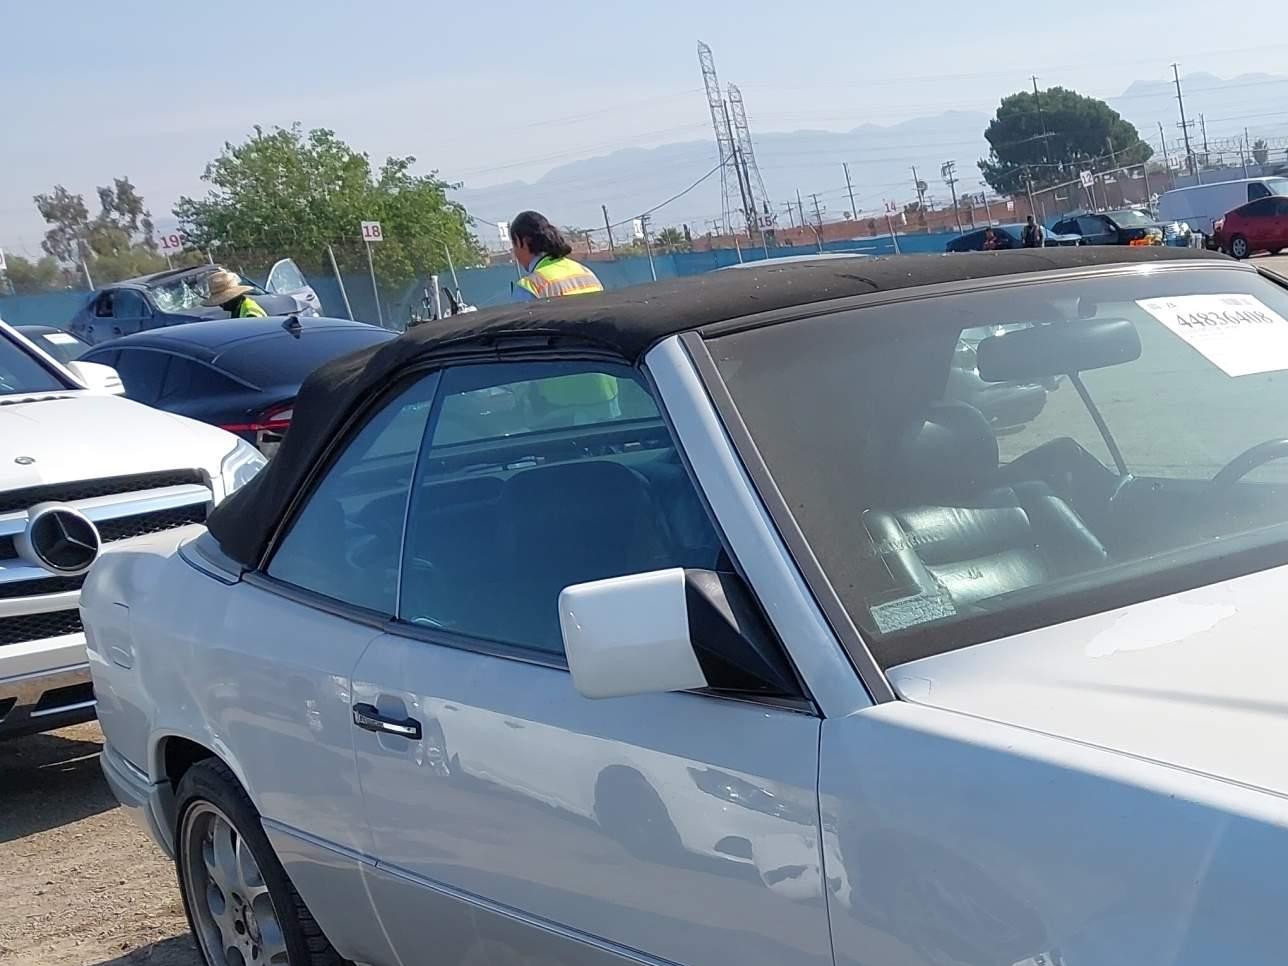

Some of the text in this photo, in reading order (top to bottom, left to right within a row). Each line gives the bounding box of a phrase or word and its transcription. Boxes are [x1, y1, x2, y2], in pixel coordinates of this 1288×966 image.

[1081, 173, 1092, 184] 12
[885, 202, 896, 213] 14
[759, 216, 772, 229] 15
[363, 224, 381, 238] 18
[162, 234, 180, 249] 19
[1176, 310, 1273, 328] 44836408
